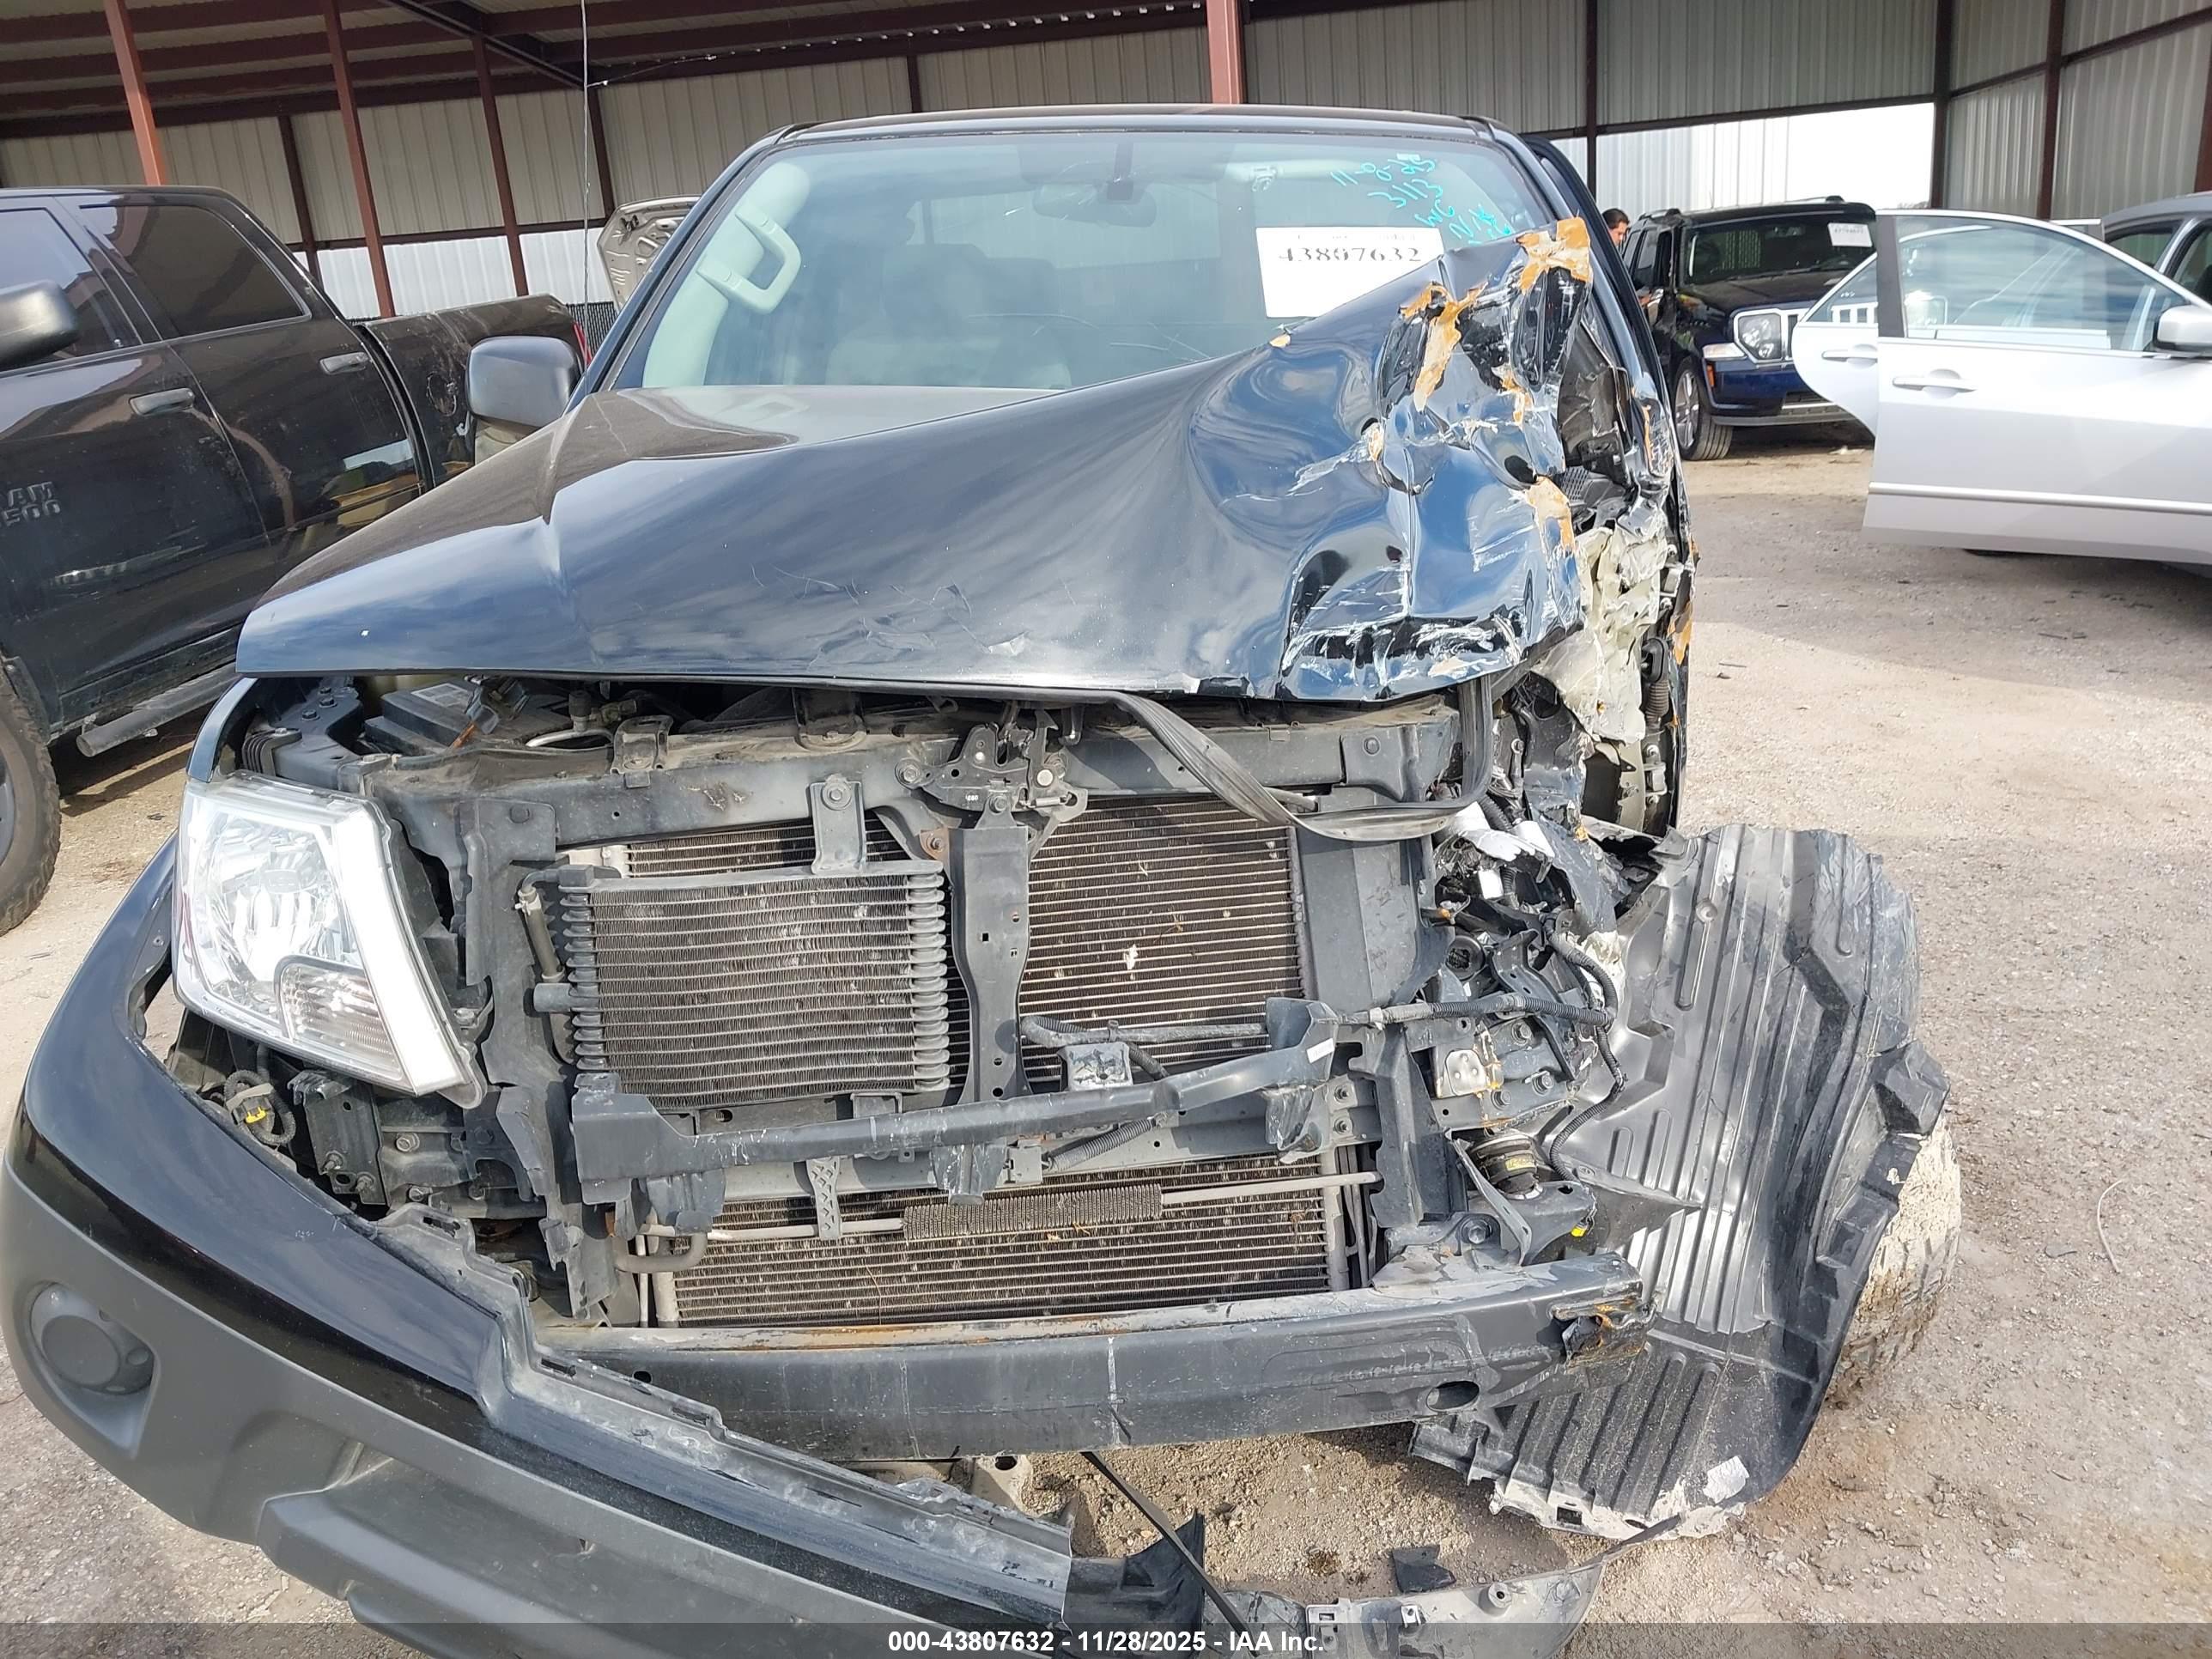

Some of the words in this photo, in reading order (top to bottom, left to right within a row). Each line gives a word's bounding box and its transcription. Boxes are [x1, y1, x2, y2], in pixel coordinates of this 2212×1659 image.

[1279, 247, 1421, 262] 43807632
[0, 481, 52, 508] AM
[0, 499, 61, 527] 500
